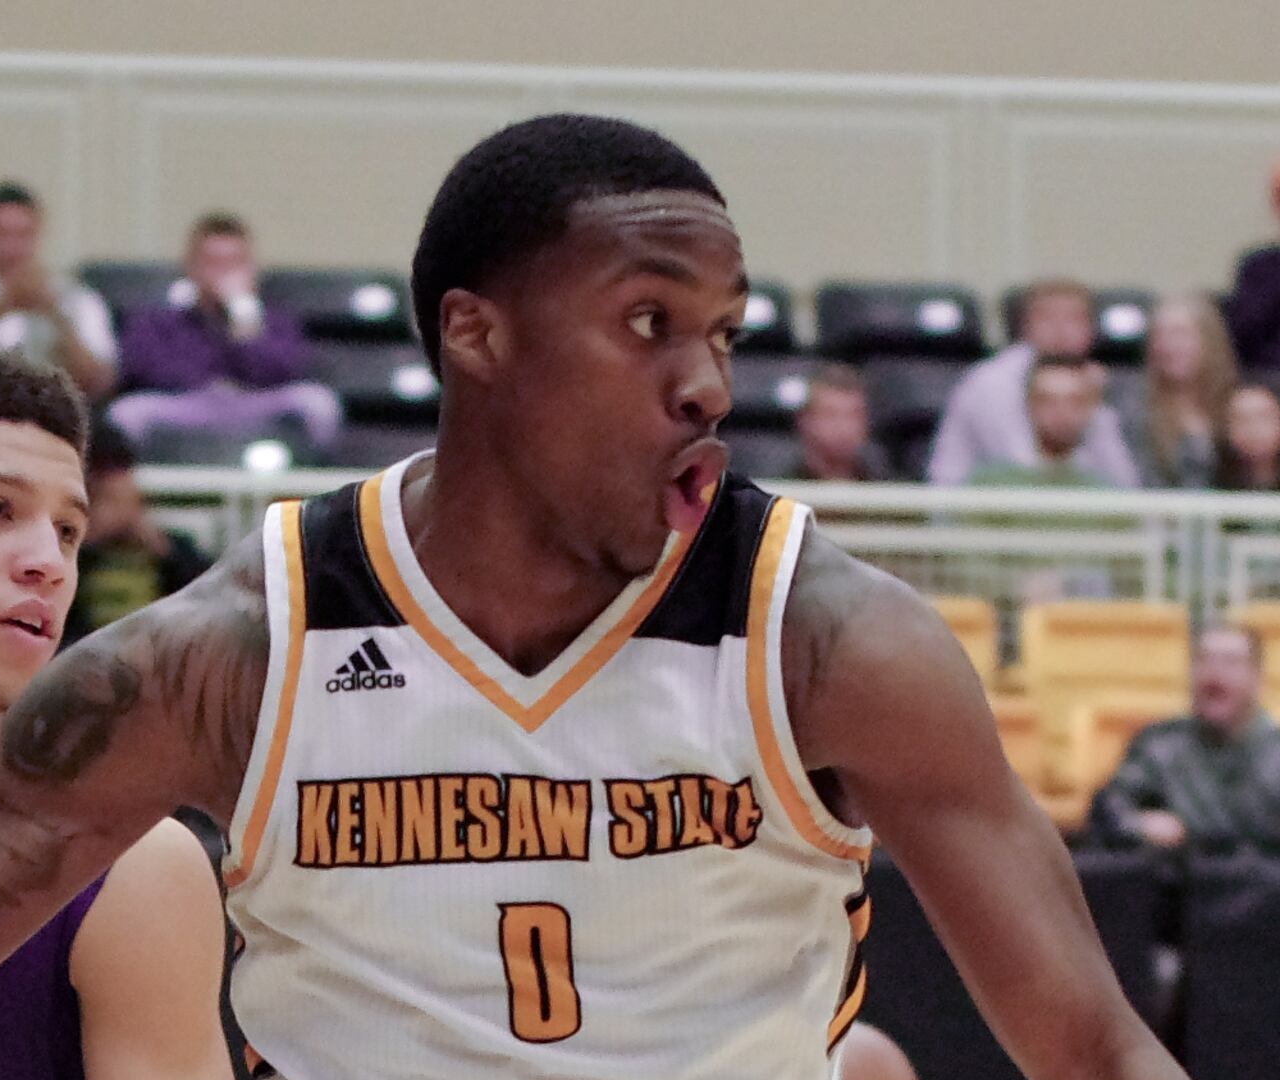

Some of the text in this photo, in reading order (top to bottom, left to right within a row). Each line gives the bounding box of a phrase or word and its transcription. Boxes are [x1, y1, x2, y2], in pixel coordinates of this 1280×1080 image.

[325, 670, 406, 693] adidas
[293, 774, 764, 869] KENNESAW STATE
[497, 902, 582, 1044] 0
